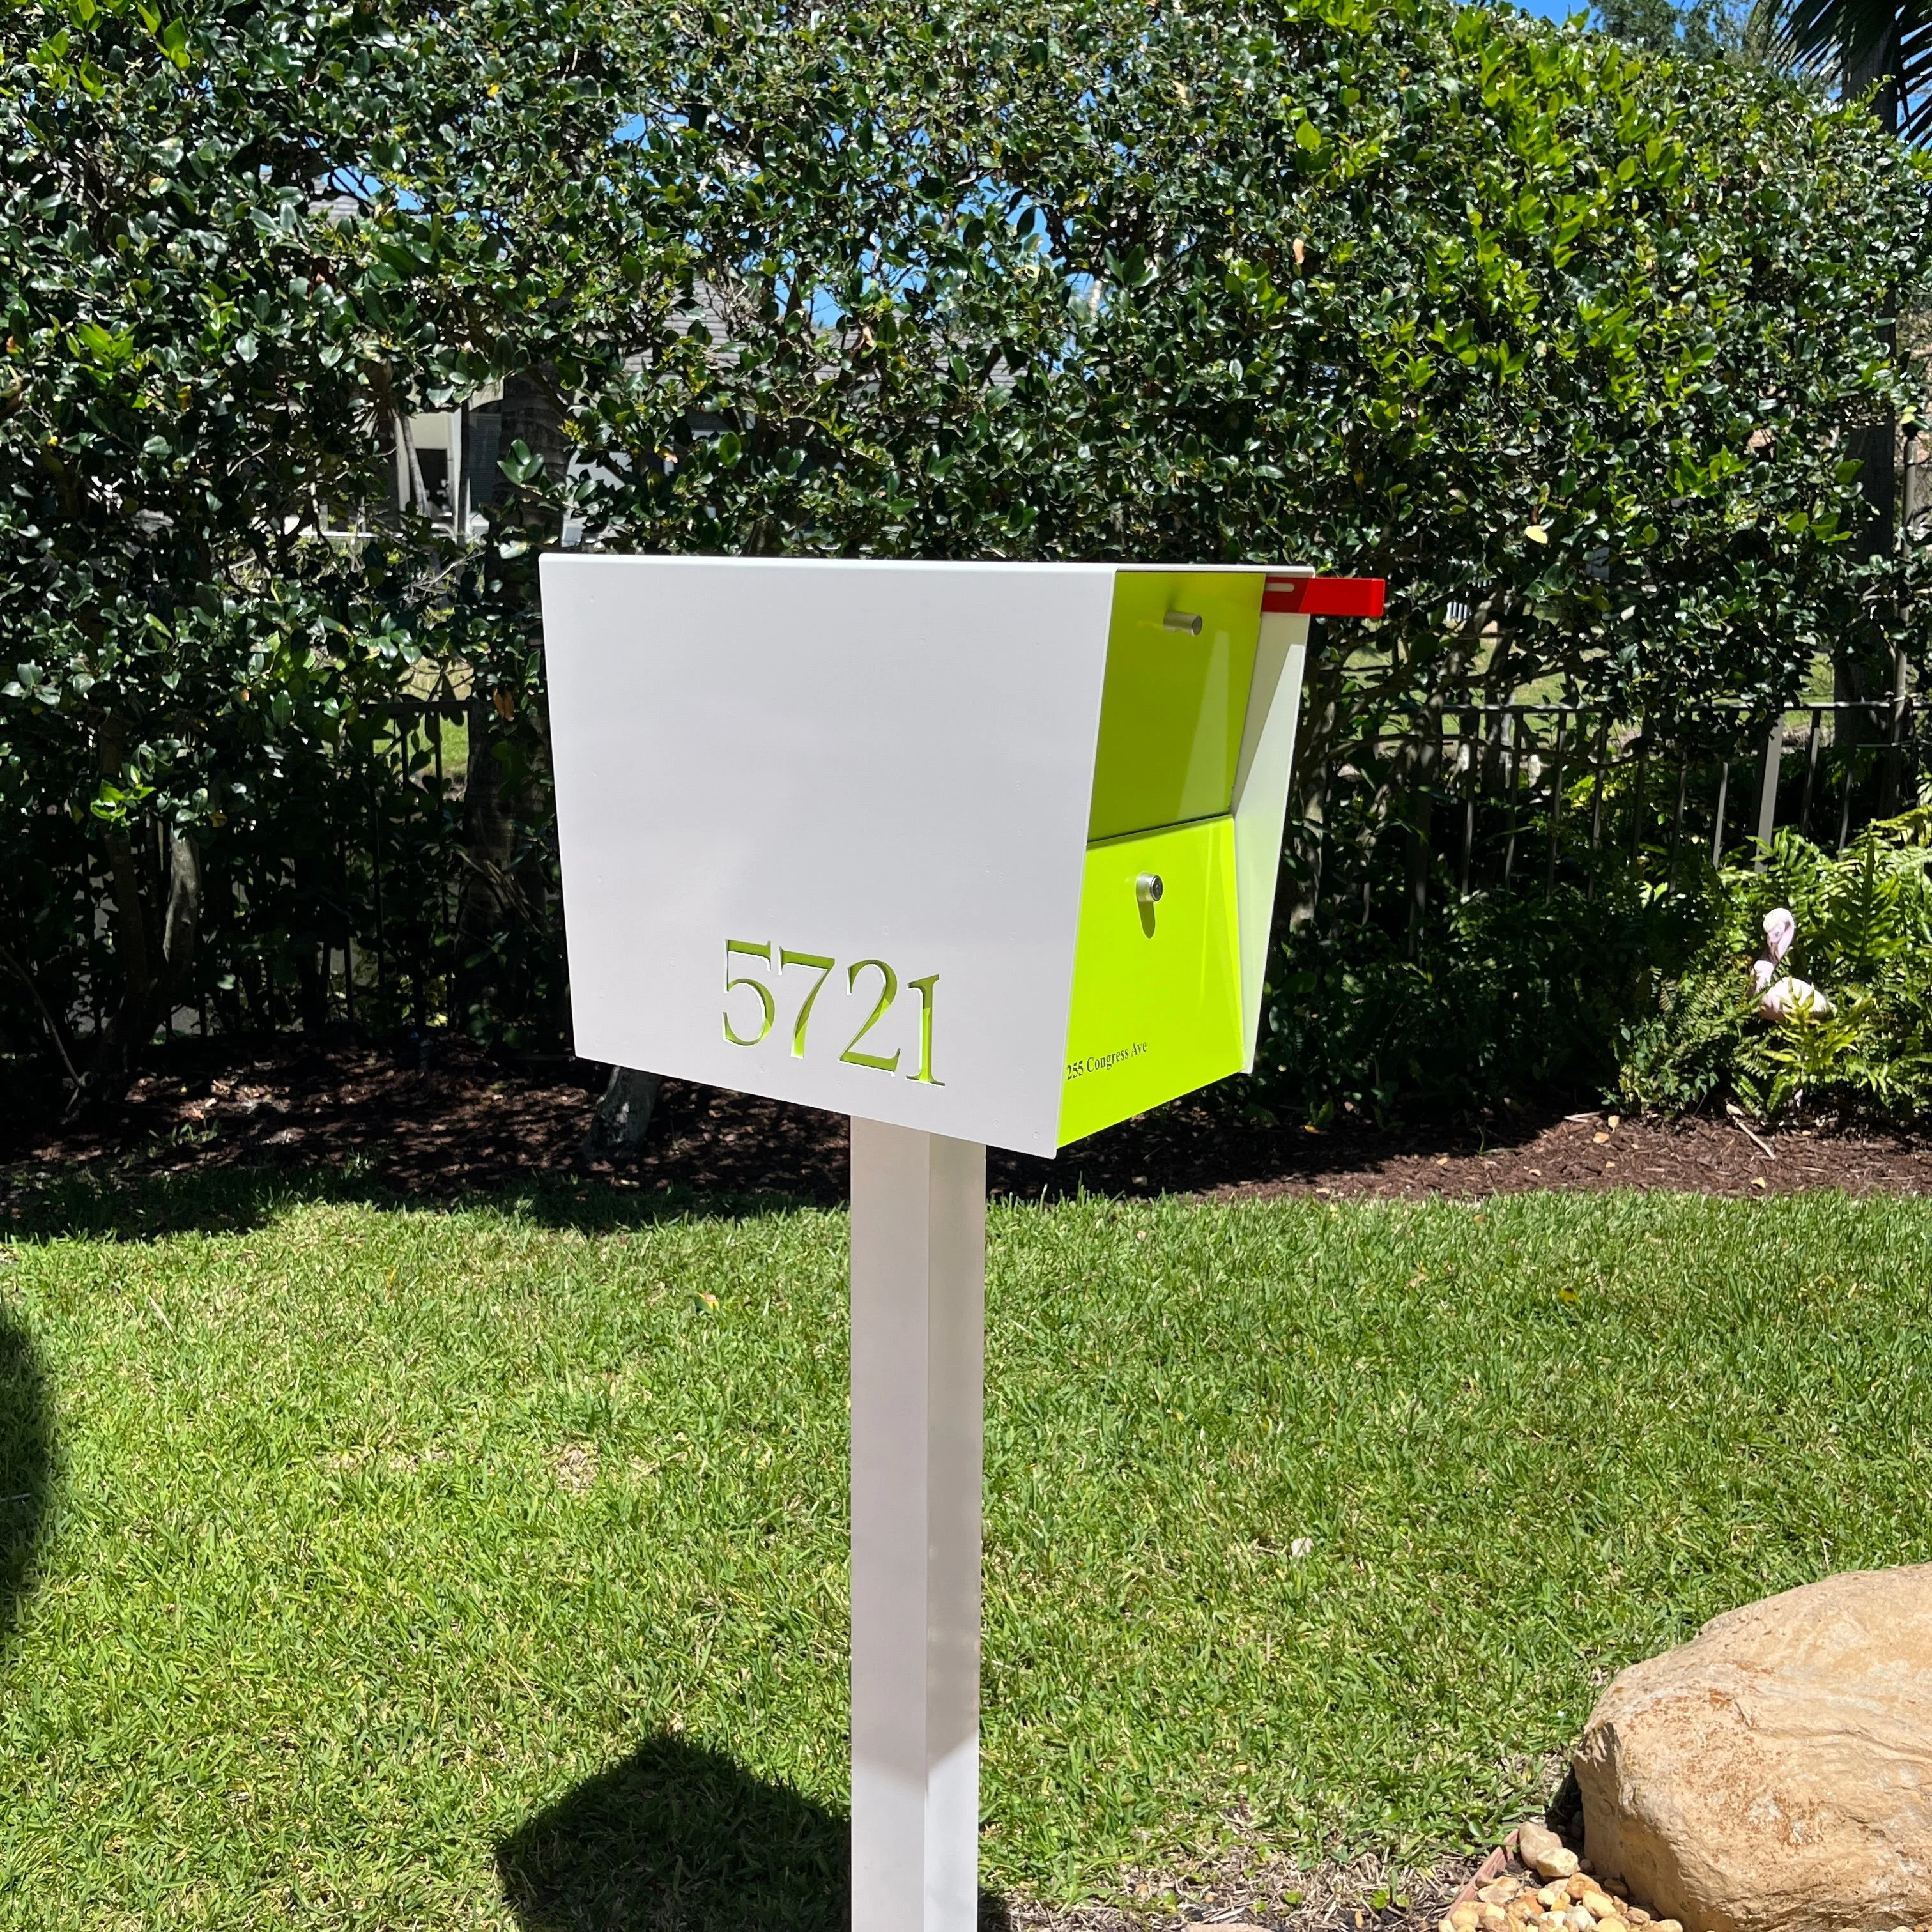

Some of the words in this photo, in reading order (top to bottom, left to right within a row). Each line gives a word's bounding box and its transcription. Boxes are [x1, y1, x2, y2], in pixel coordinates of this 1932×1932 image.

[722, 939, 946, 1087] 5721
[1066, 1060, 1084, 1080] 255
[1086, 1048, 1129, 1072] Congress
[1131, 1041, 1147, 1057] Ave
